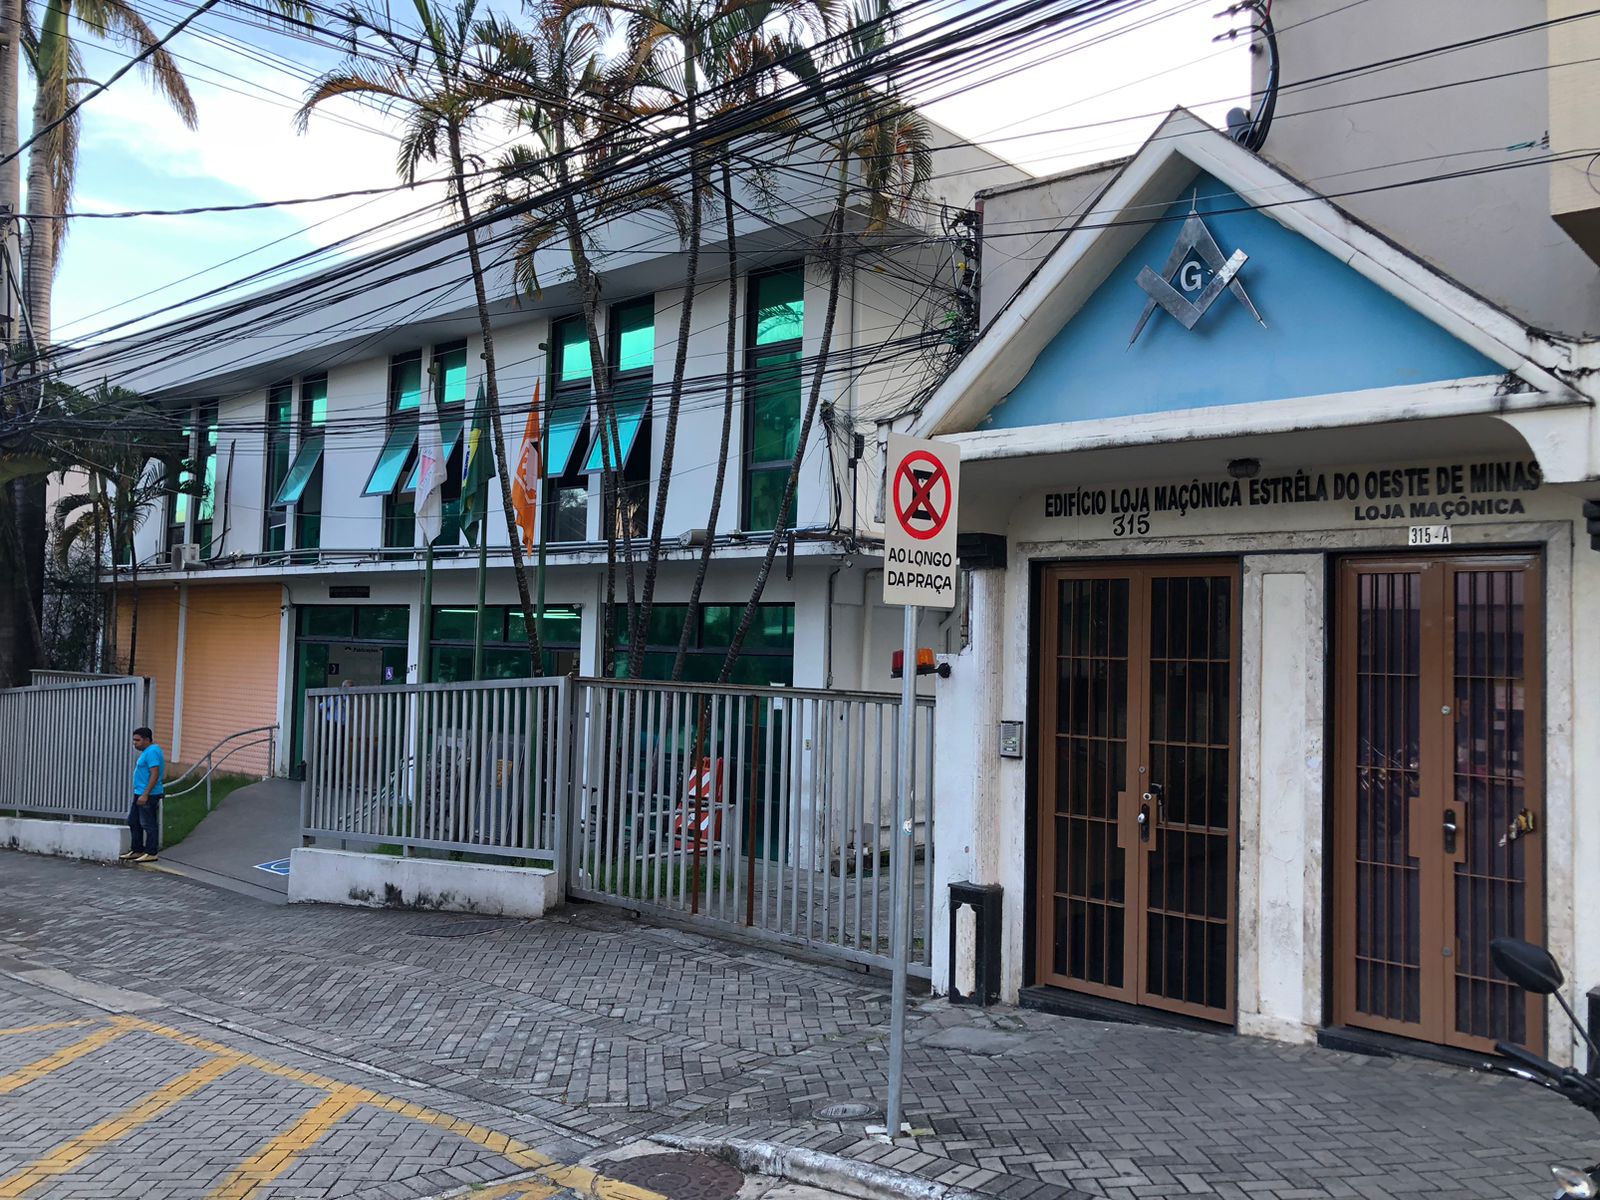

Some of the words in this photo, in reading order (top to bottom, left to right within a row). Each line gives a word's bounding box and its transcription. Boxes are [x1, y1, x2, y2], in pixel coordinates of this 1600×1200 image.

[1180, 261, 1202, 292] G
[1045, 486, 1106, 517] EDIFÍCIO
[1111, 487, 1150, 514] LOJA
[1154, 479, 1242, 516] MAÇÔNICA
[1334, 472, 1359, 500] DO
[1365, 468, 1429, 499] OESTE
[1437, 465, 1464, 494] DE
[1470, 460, 1541, 493] MINAS
[1355, 504, 1405, 521] LOJA
[1410, 496, 1525, 520] MAÇÔNICA
[1112, 512, 1150, 536] 315
[888, 547, 906, 563] AO
[908, 549, 952, 567] LONGO
[888, 570, 905, 587] DA
[907, 573, 952, 594] PRAÇA
